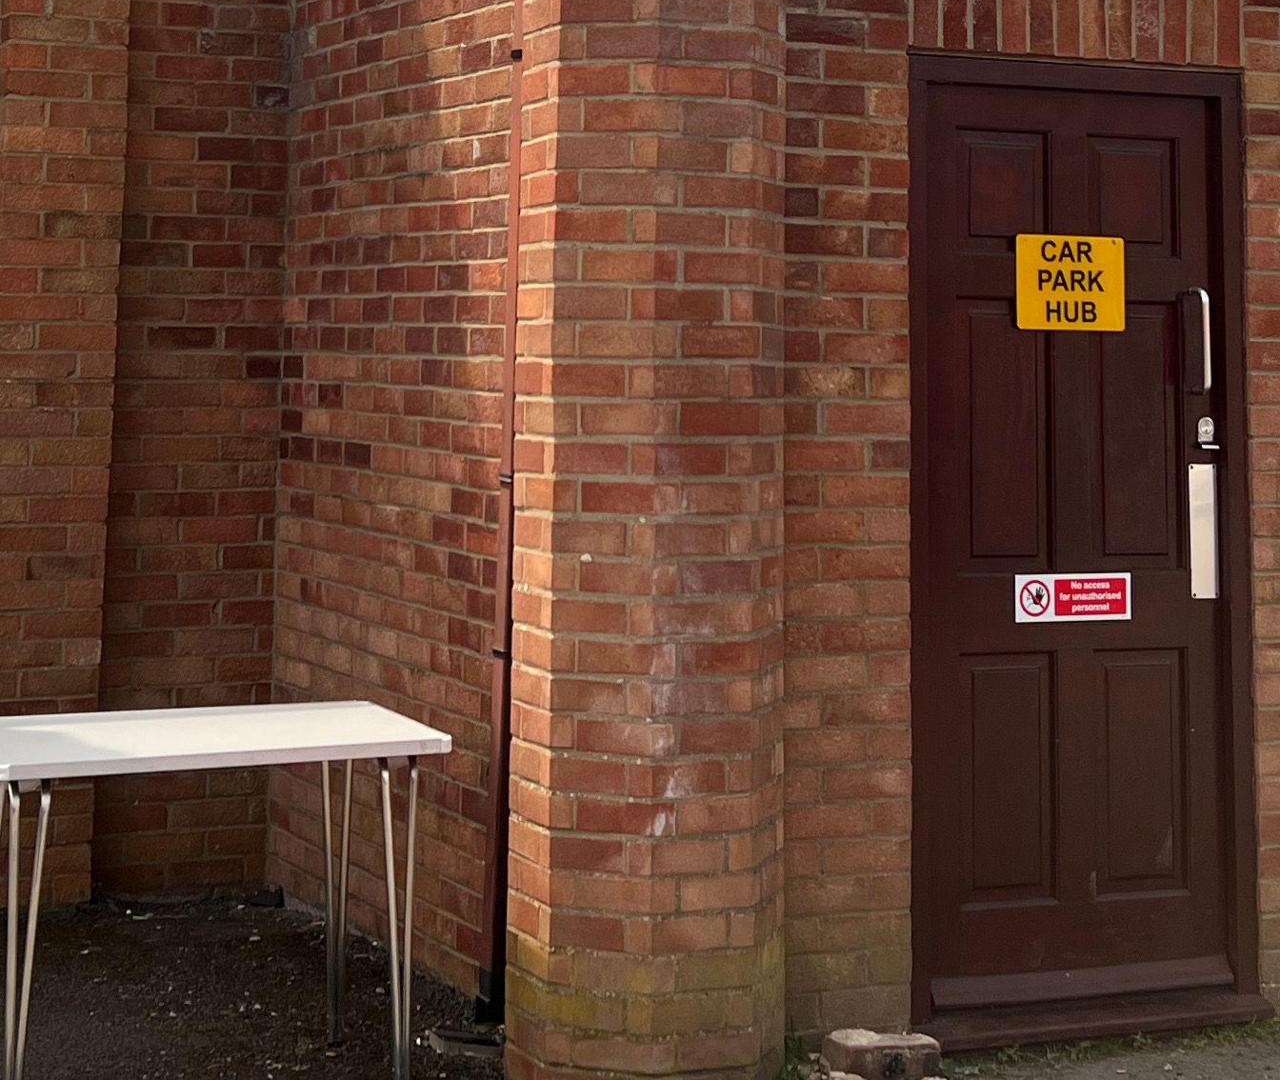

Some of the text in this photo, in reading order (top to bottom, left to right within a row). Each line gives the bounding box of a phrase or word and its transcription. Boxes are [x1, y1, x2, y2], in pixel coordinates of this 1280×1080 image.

[1041, 240, 1092, 263] CAR
[1038, 270, 1104, 292] PARK
[1046, 300, 1097, 323] HUB
[1071, 581, 1081, 589] No
[1072, 592, 1121, 600] unauthorised
[1072, 603, 1110, 613] personnel
